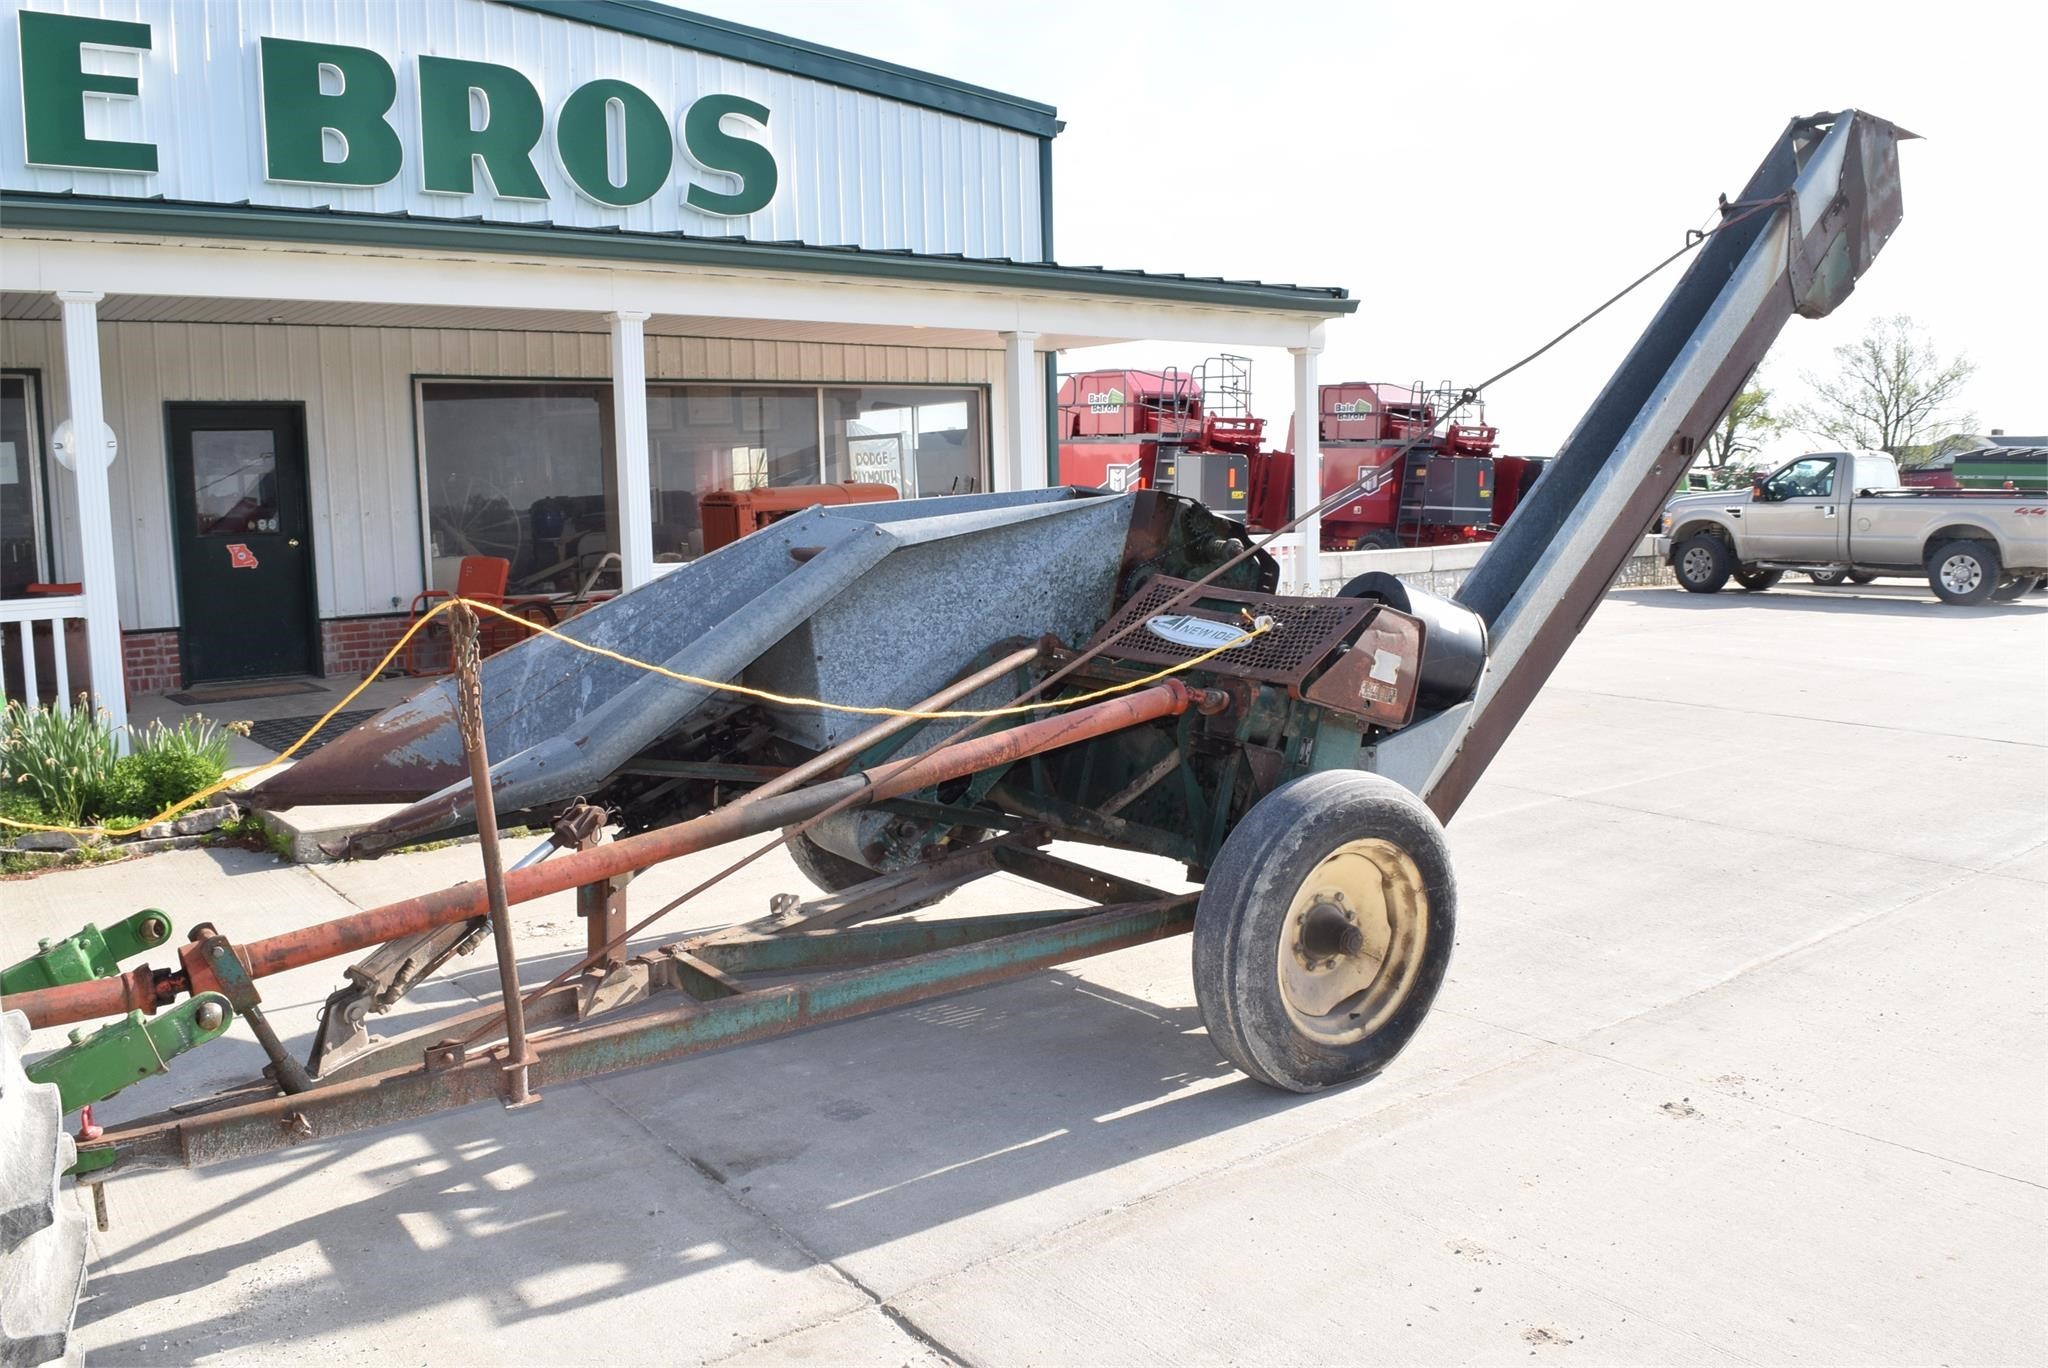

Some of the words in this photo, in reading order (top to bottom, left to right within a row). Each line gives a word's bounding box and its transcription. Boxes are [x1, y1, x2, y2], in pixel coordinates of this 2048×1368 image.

[17, 8, 159, 175] E
[259, 36, 779, 217] BROS
[1089, 394, 1108, 403] Bale
[1335, 403, 1355, 412] Bale
[853, 469, 898, 484] PLYMOUTH
[1182, 624, 1213, 637] NEW
[1213, 628, 1239, 641] IDE
